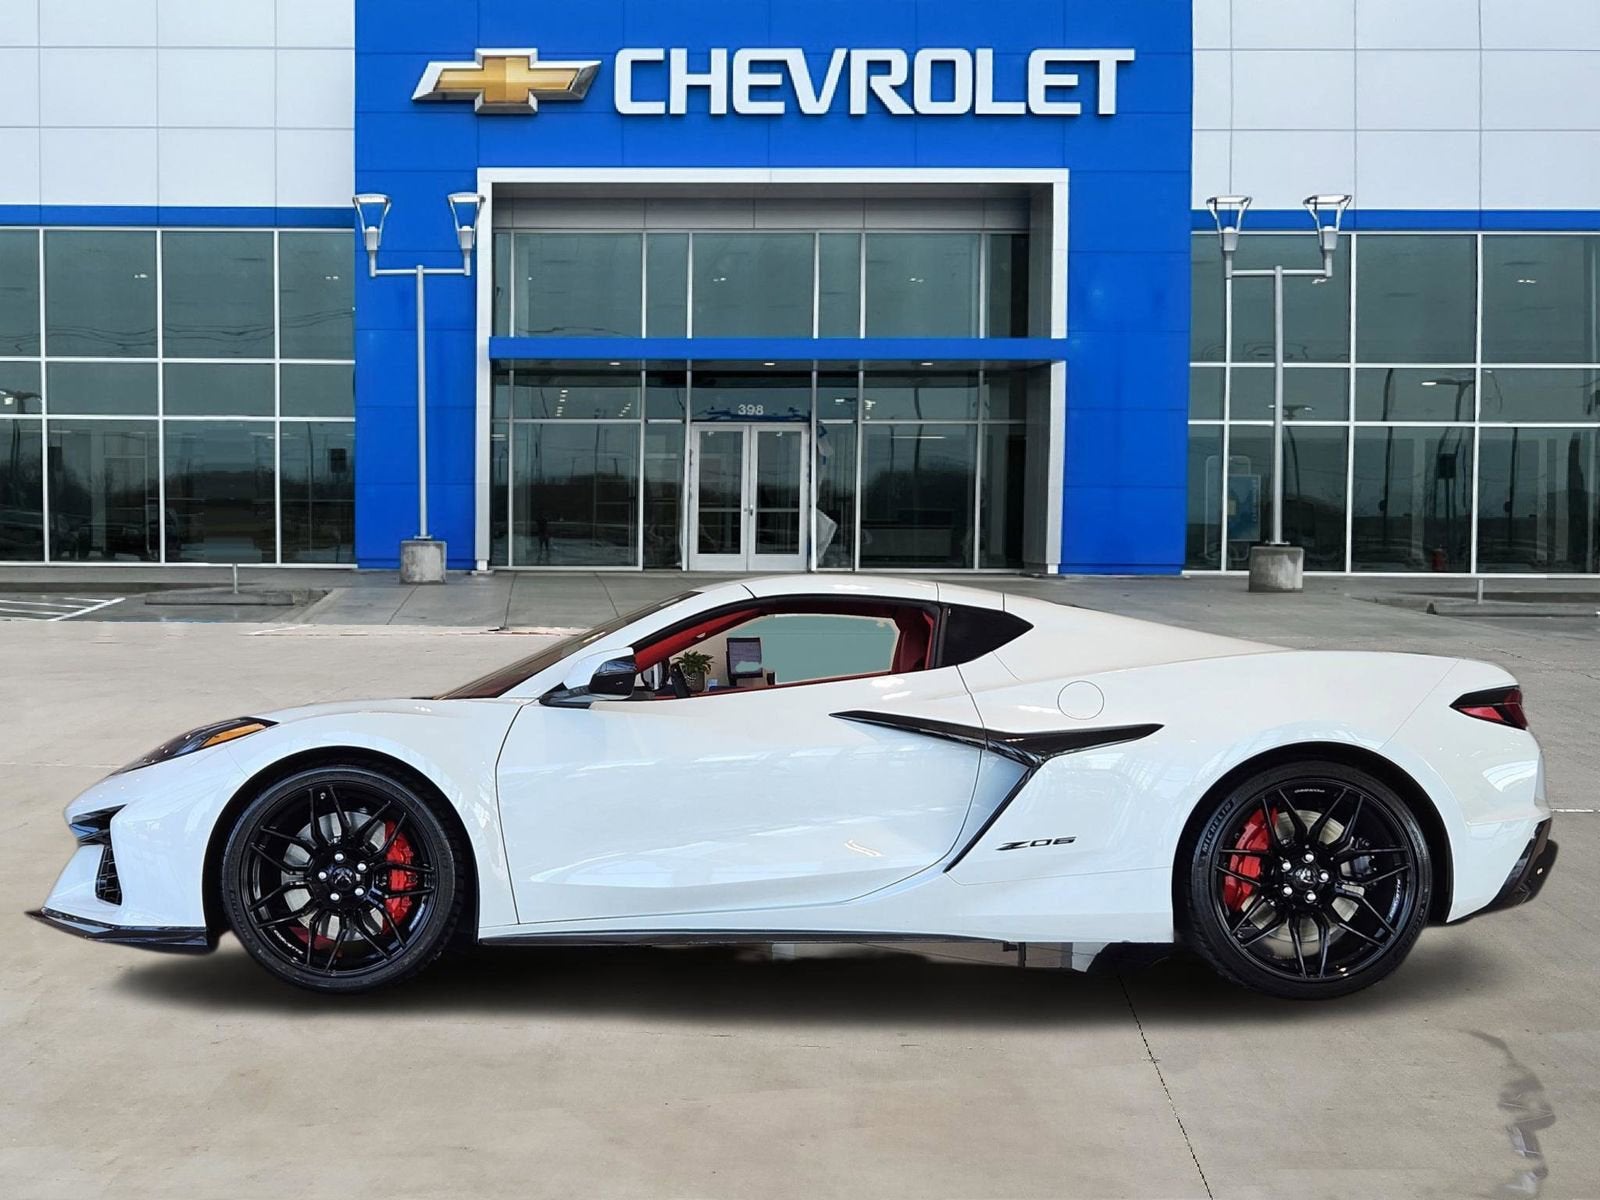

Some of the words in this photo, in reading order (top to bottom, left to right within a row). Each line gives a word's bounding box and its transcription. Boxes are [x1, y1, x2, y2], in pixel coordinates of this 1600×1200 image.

[614, 48, 1135, 114] CHEVROLET
[737, 404, 764, 416] 398
[995, 836, 1077, 851] Z06
[1201, 801, 1233, 853] MICHELIN
